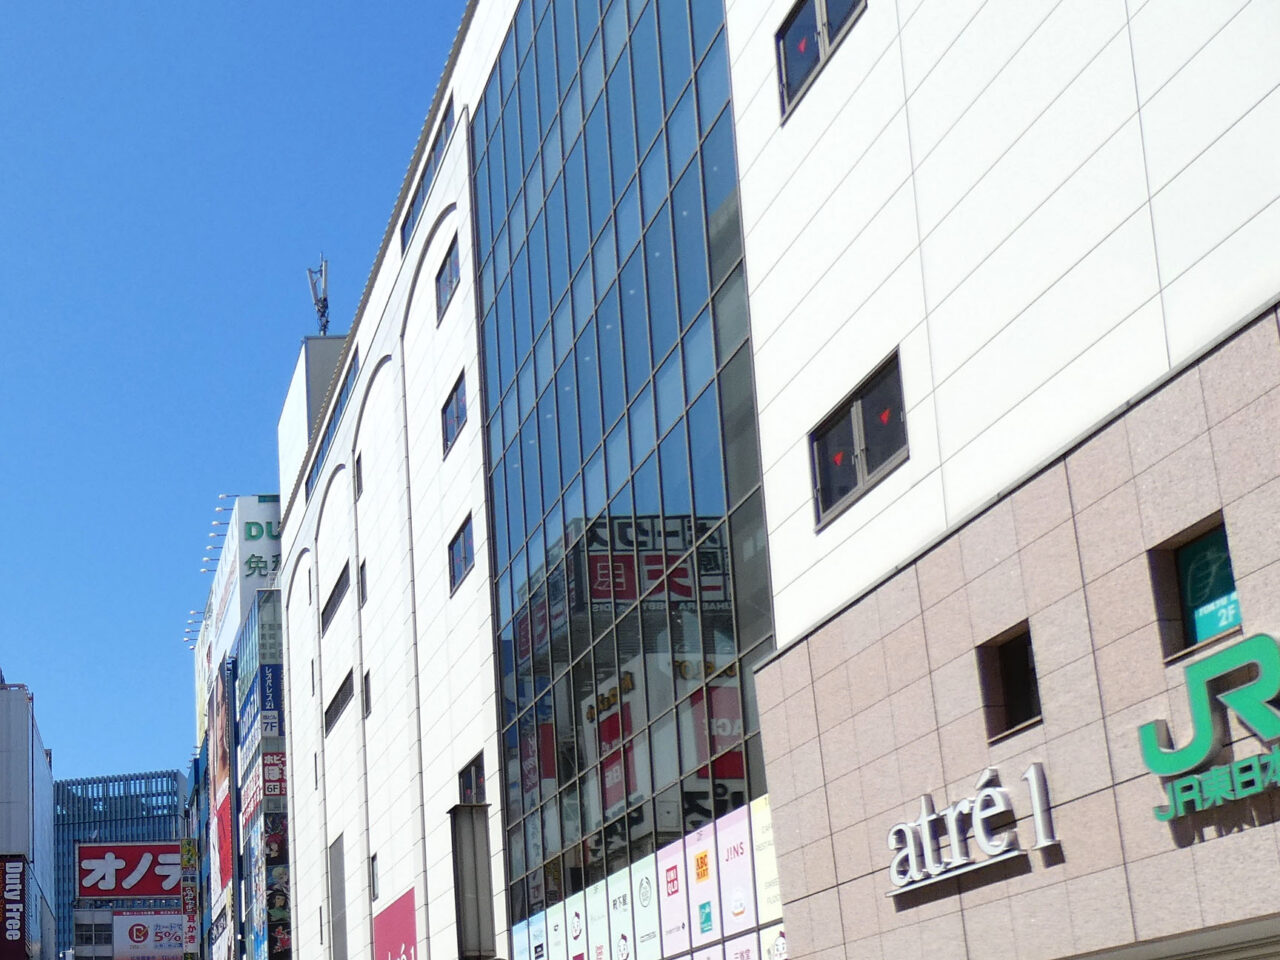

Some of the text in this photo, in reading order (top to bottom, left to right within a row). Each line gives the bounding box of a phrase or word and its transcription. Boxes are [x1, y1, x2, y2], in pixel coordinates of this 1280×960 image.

[1217, 603, 1237, 628] 2F
[1137, 632, 1280, 777] JR
[263, 721, 277, 732] 7F
[267, 784, 278, 793] 6F
[887, 762, 1062, 888] atré 1
[695, 854, 708, 871] ABC
[696, 868, 709, 882] MART
[5, 862, 23, 941] Duty Free
[154, 931, 182, 942] 5%
